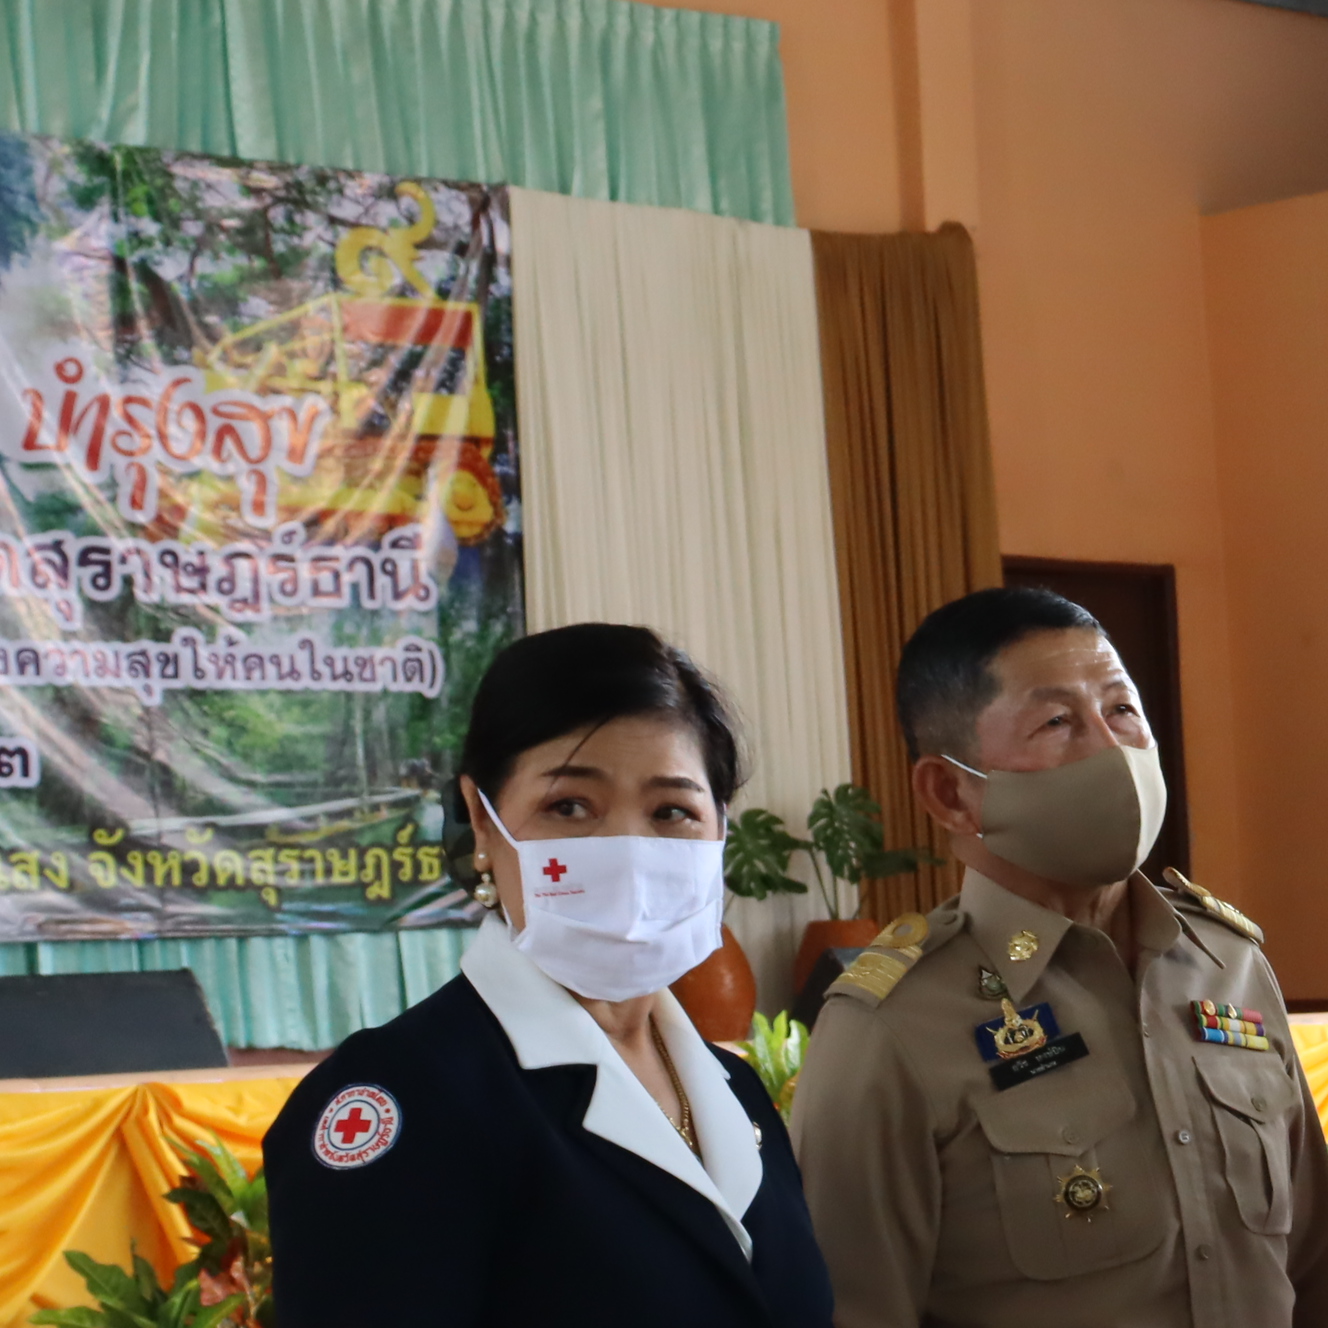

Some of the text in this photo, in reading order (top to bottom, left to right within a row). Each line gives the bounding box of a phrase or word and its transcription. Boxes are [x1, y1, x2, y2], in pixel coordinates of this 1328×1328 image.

[22, 356, 323, 518] บำรุงสุข
[0, 822, 445, 908] สง จังหวัดสุราษฎร์ธ
